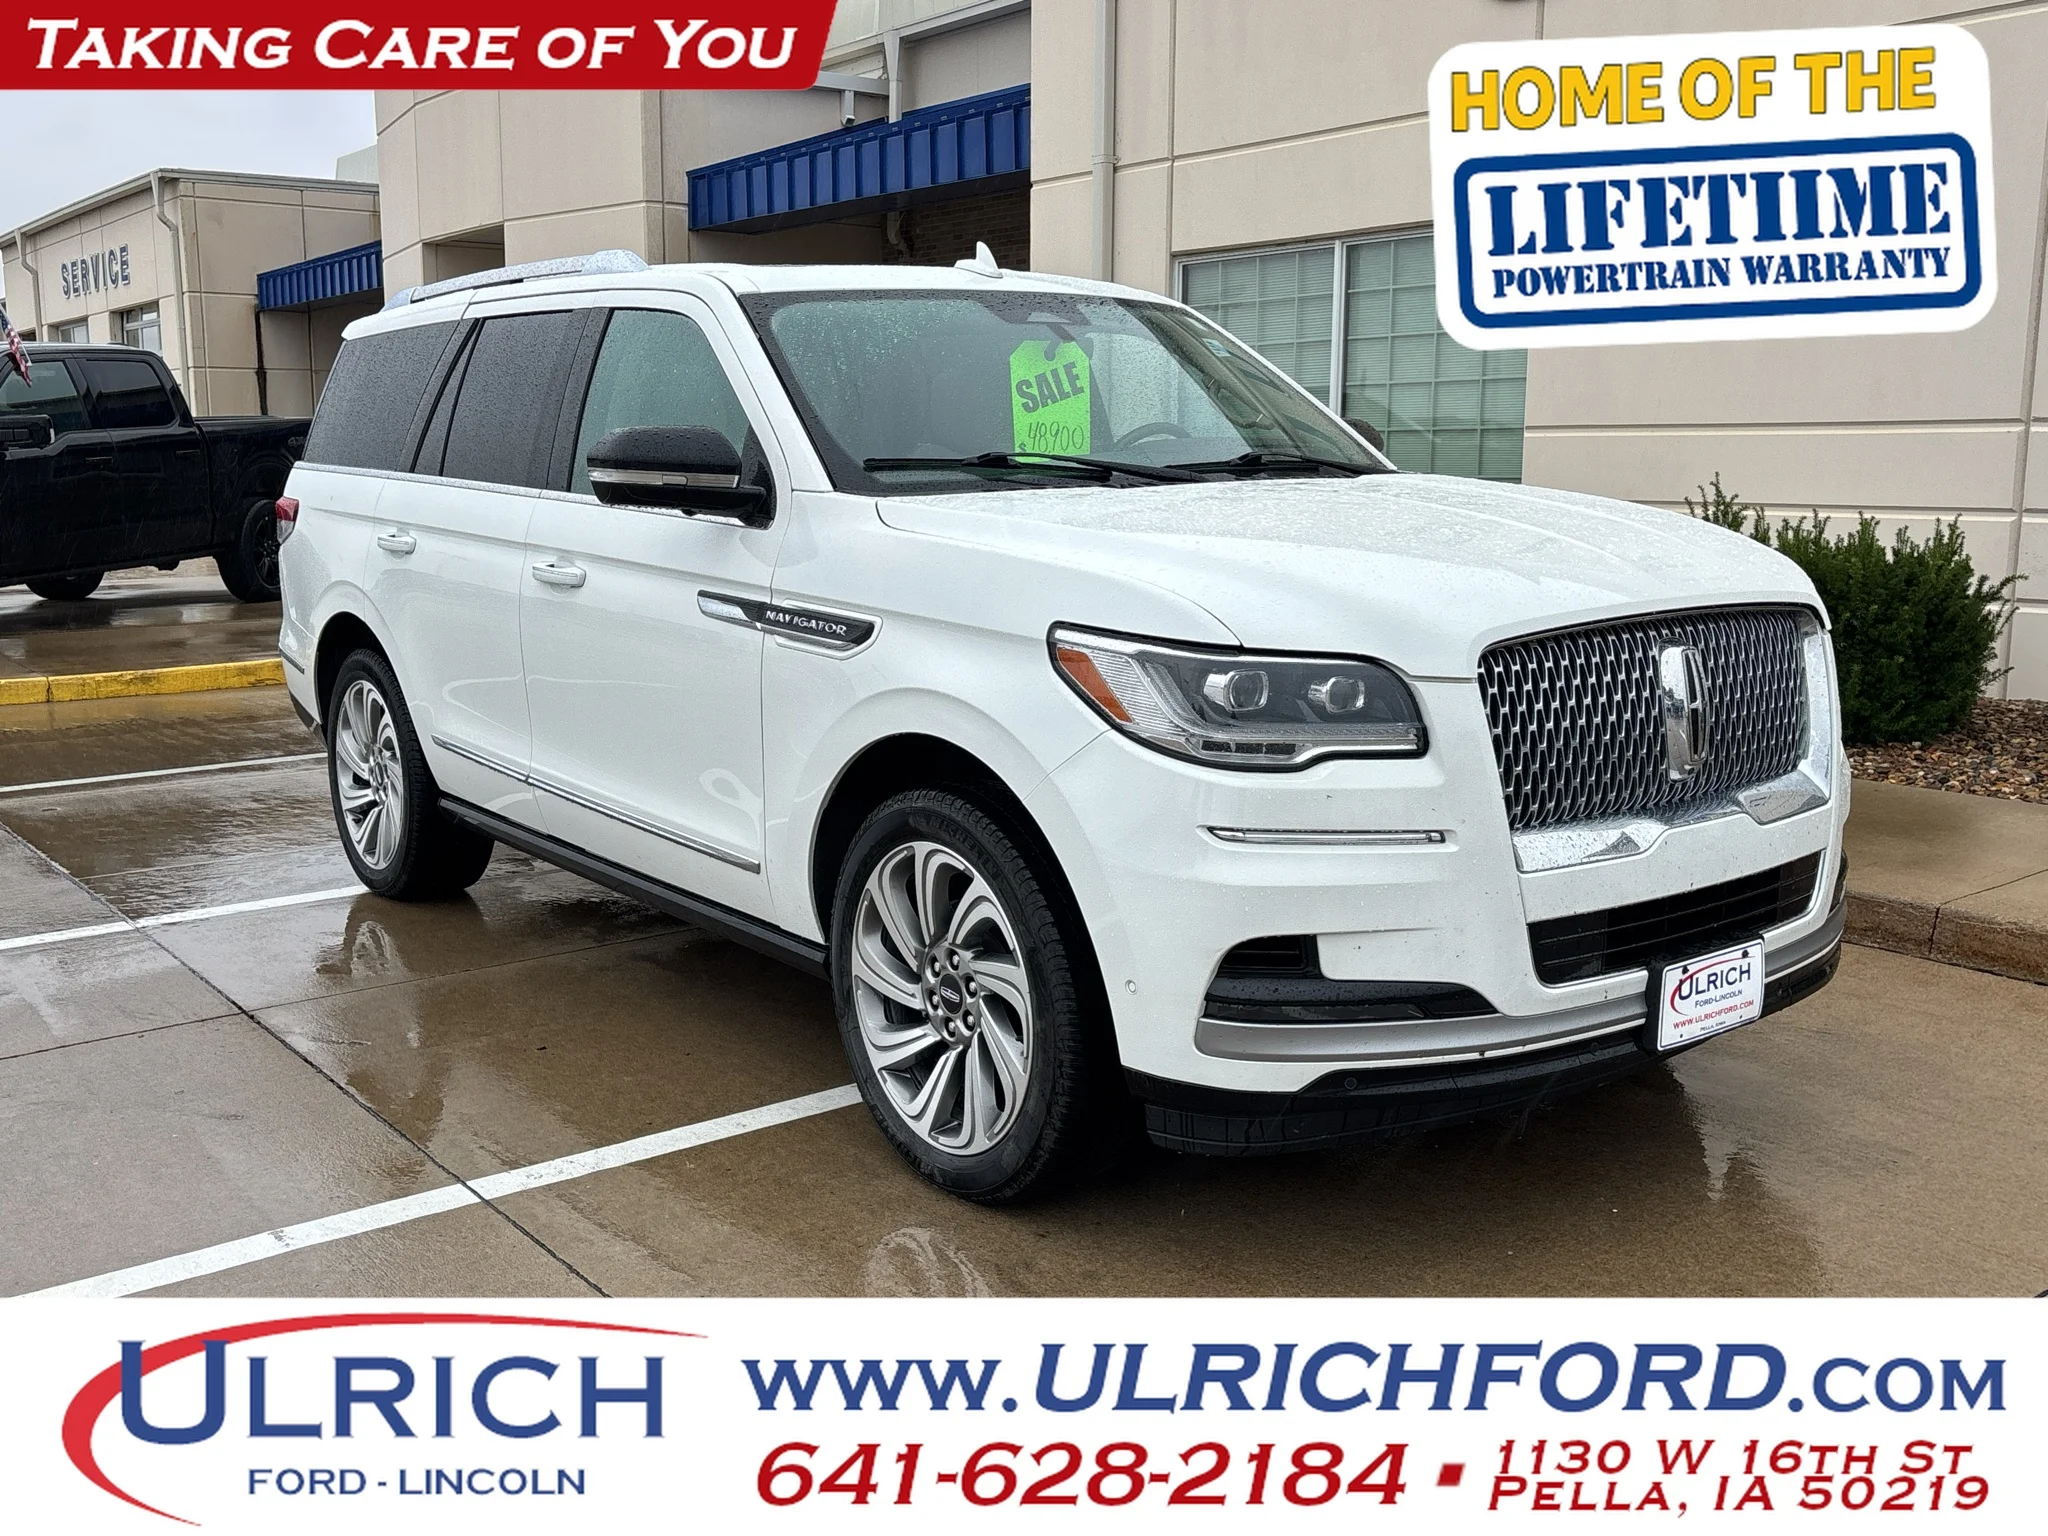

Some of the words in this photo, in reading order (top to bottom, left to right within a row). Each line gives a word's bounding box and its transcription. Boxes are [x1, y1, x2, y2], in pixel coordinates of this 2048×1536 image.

[61, 243, 130, 299] SERVICE
[1015, 361, 1085, 414] SALE
[765, 610, 848, 637] NAVIGATOR
[1678, 962, 1751, 1001] ULRICH
